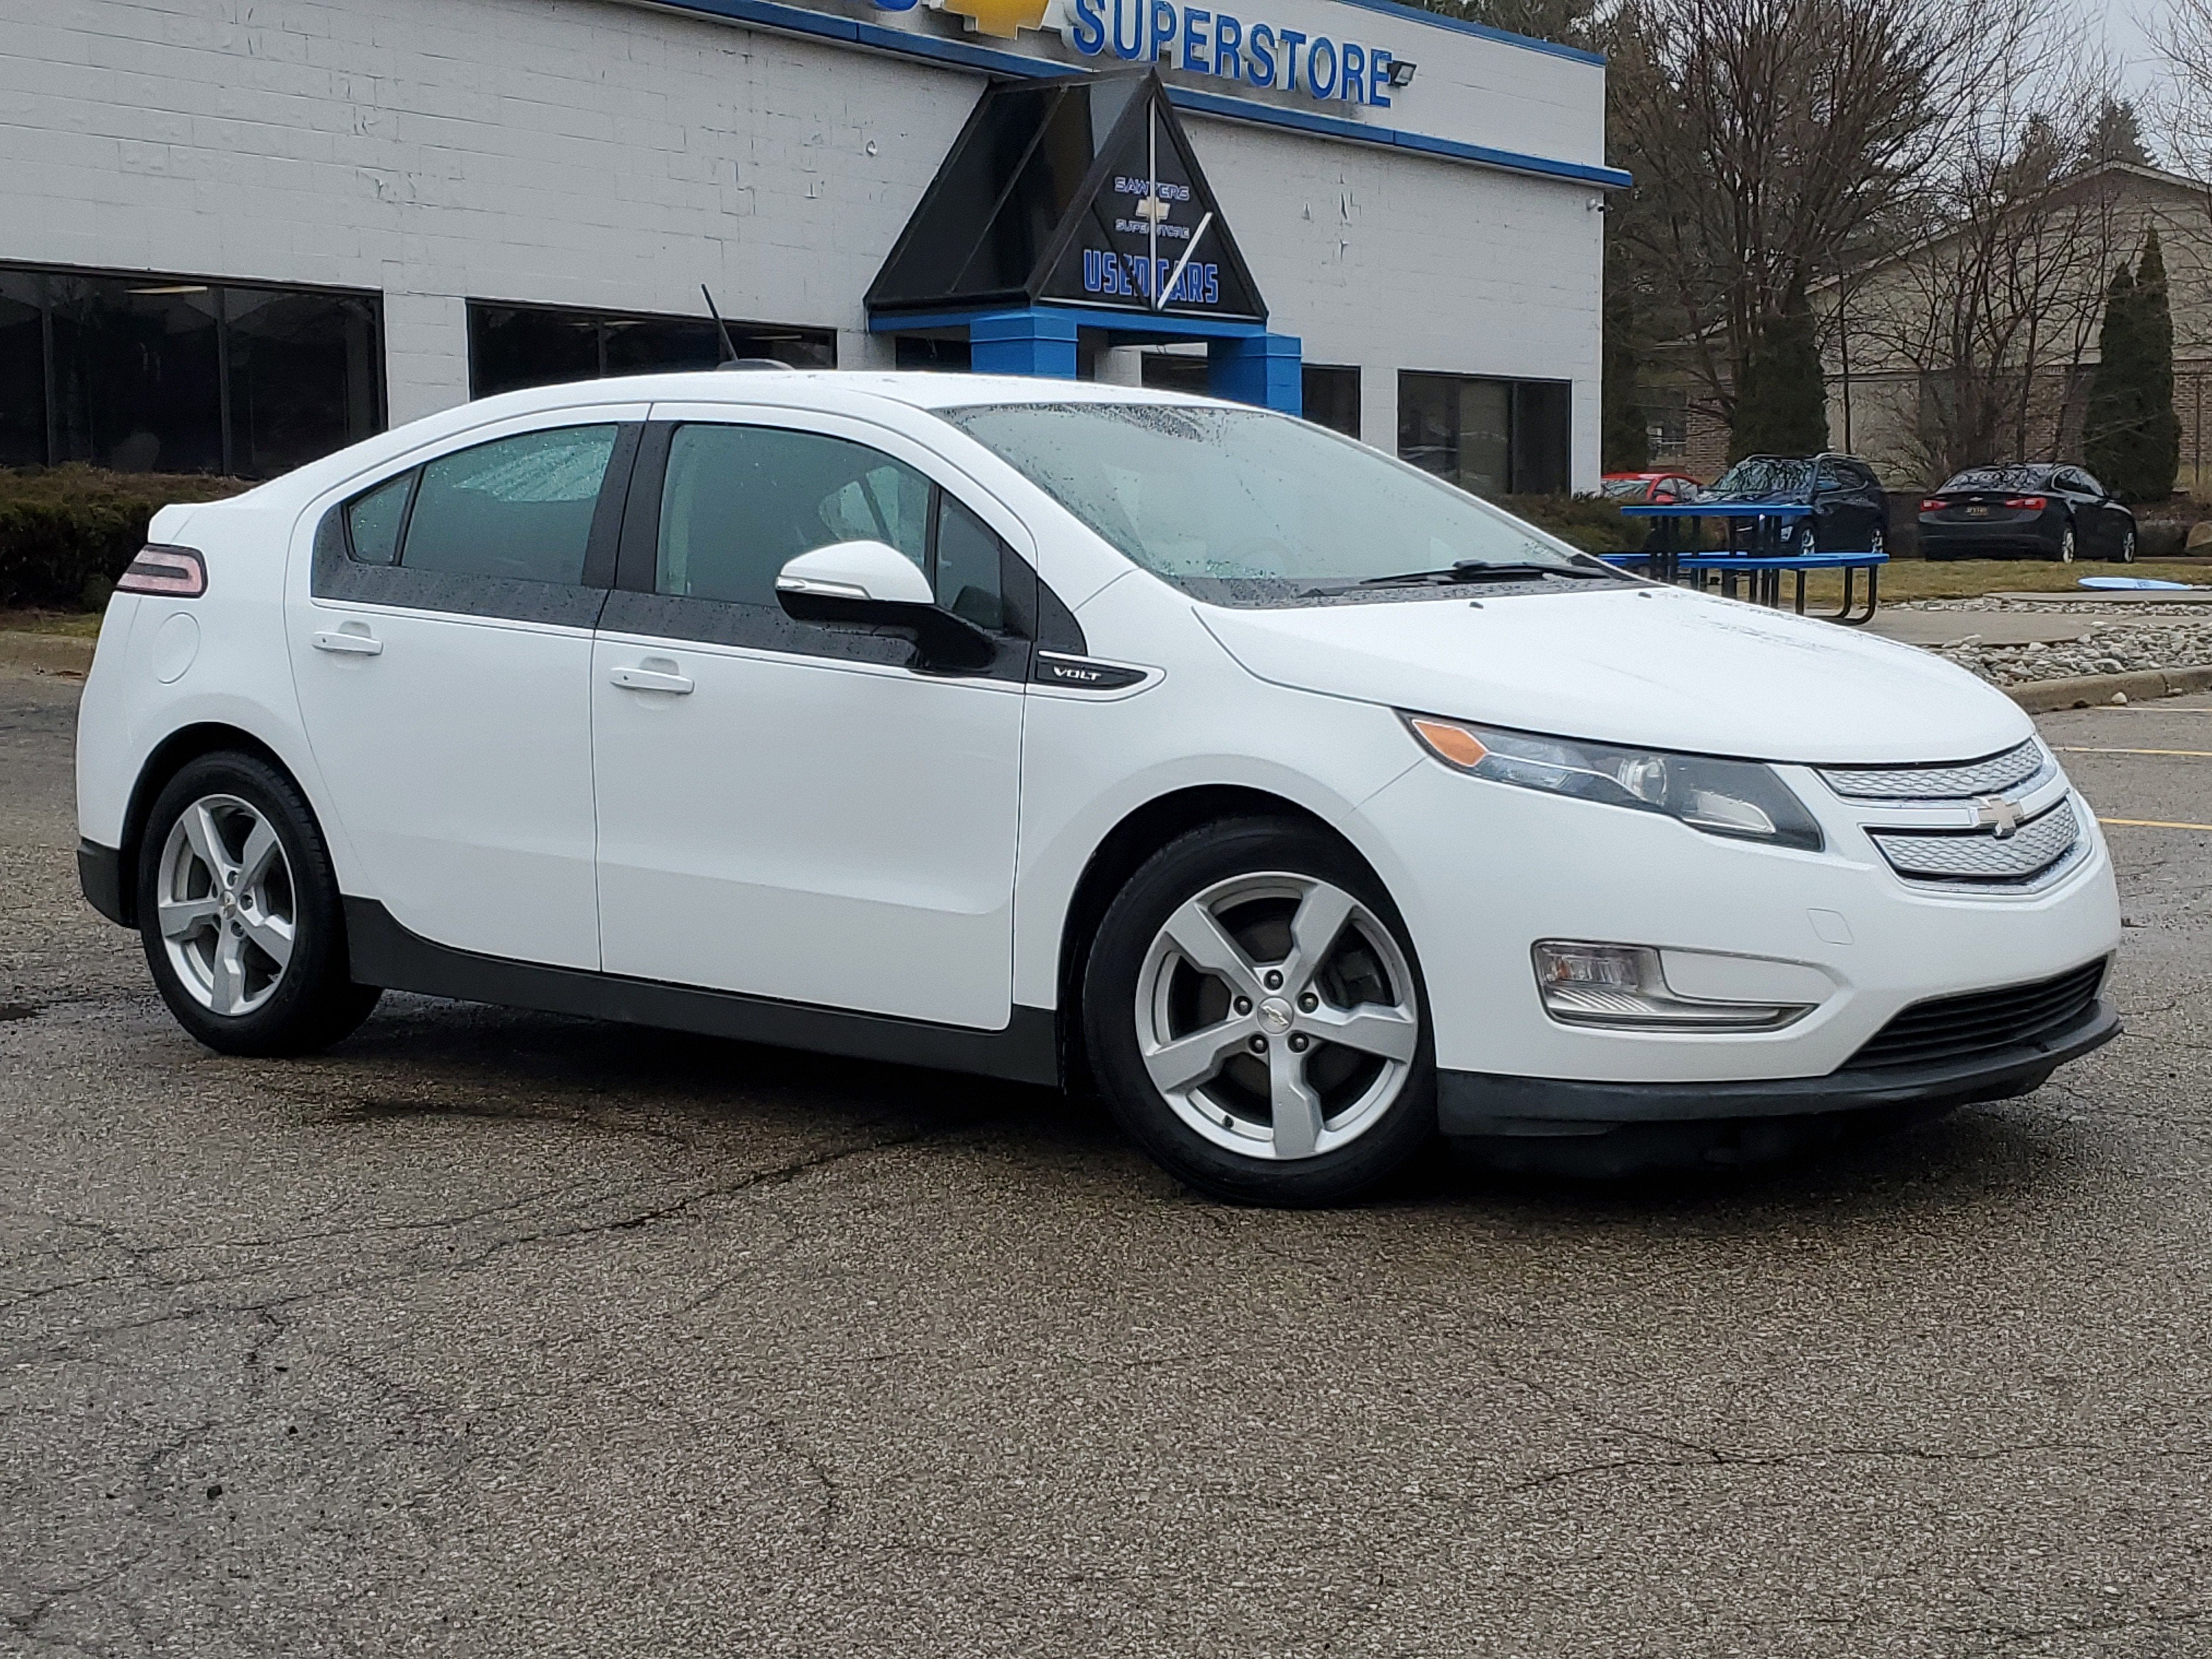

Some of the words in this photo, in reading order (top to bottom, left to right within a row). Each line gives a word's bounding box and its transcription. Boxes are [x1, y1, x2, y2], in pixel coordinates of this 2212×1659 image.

[1073, 0, 1392, 108] SUPERSTORE
[1115, 177, 1189, 201] SAWERS
[1084, 249, 1150, 297] USED
[1053, 666, 1102, 681] VOLT
